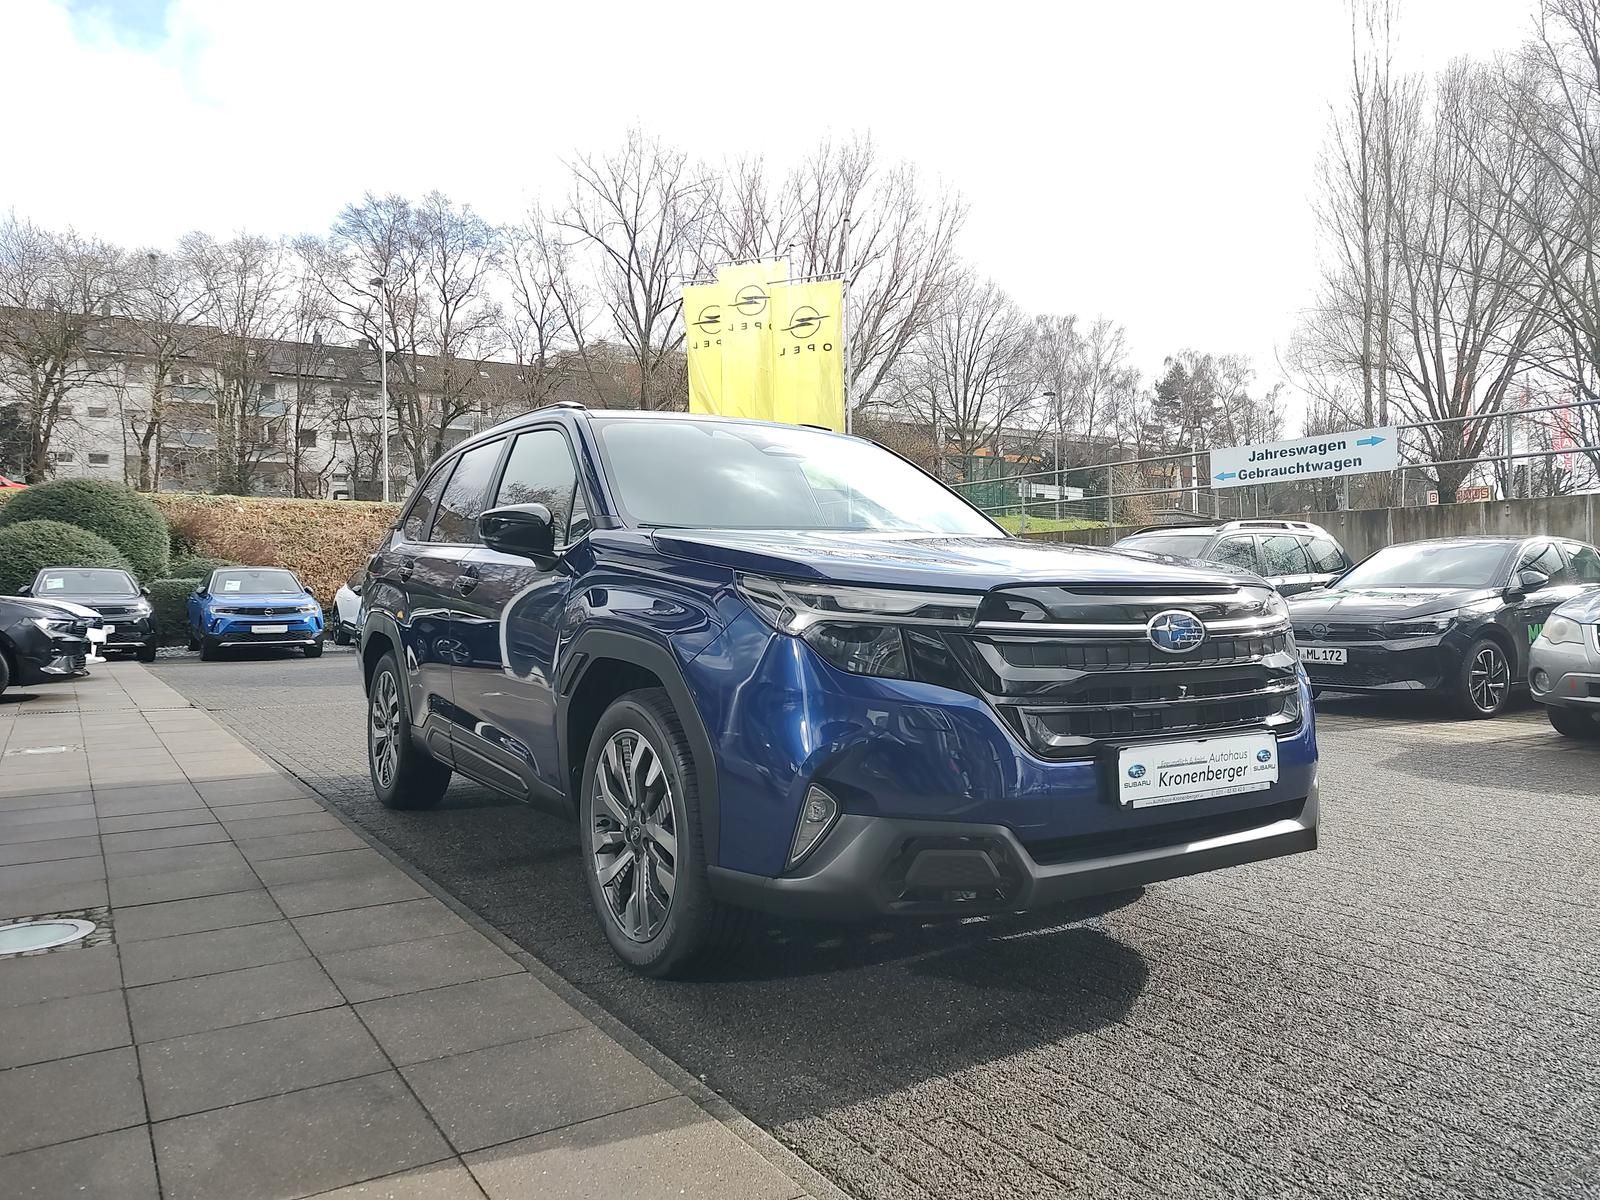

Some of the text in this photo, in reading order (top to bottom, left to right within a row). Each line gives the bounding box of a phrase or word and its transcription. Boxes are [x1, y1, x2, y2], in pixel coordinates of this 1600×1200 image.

[1248, 439, 1347, 462] Jahreswagen
[1238, 456, 1362, 481] Gebrauchtwagen
[1306, 648, 1320, 660] ML
[1322, 649, 1342, 661] 172
[1209, 750, 1248, 764] Autohaus
[1253, 763, 1276, 772] SUBARU
[1158, 764, 1248, 788] Kronenberger
[1123, 779, 1151, 789] SUBARU
